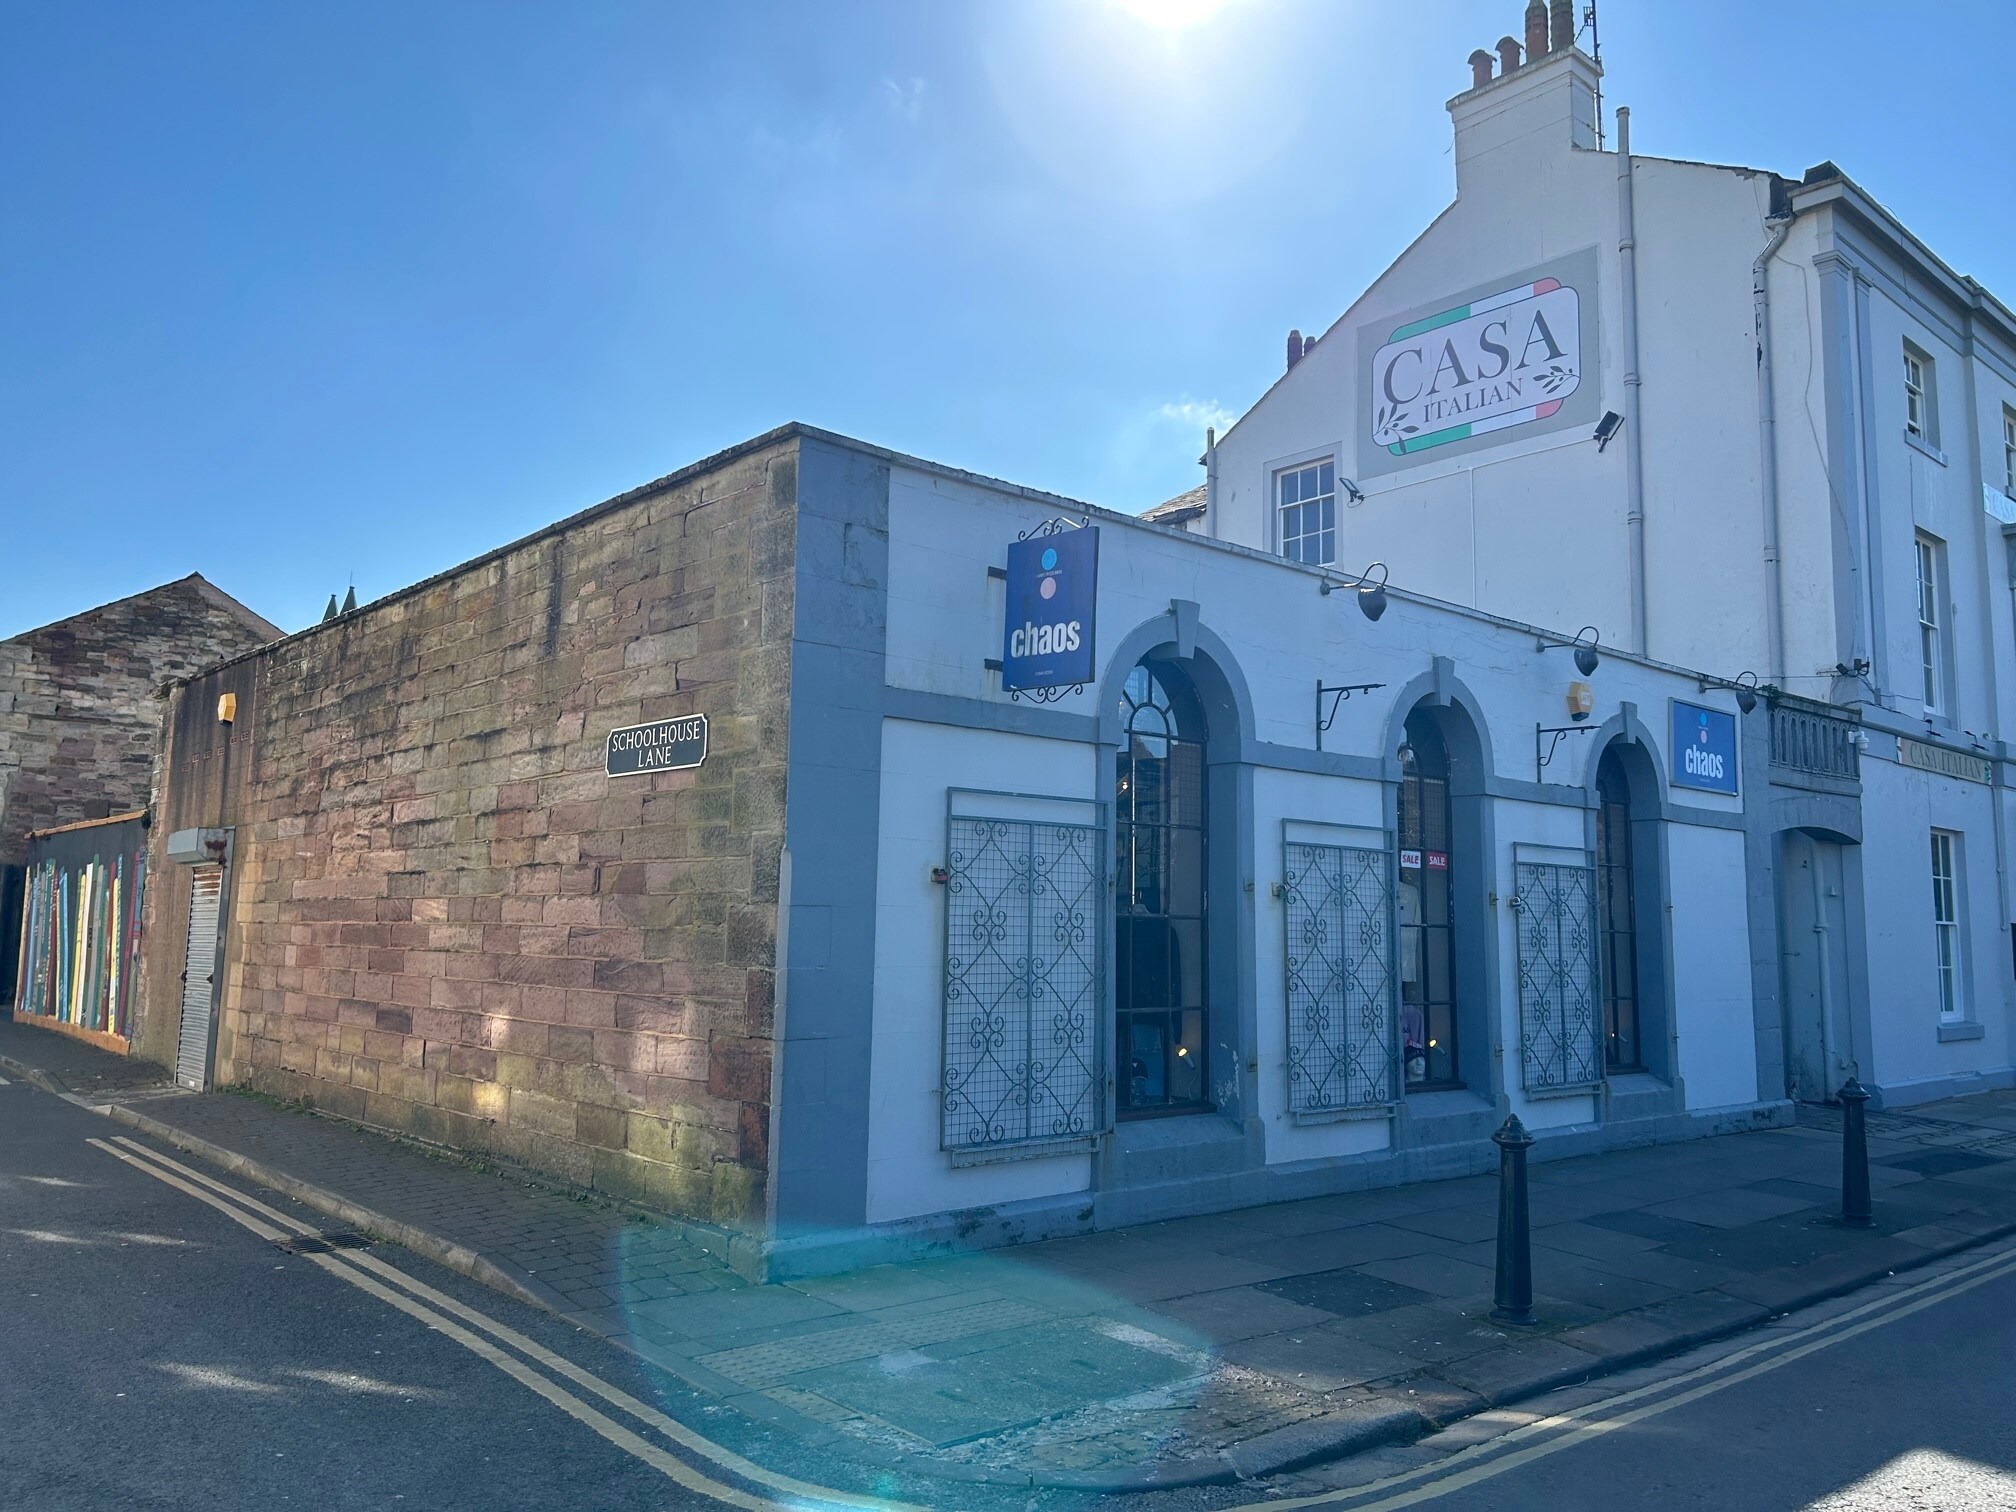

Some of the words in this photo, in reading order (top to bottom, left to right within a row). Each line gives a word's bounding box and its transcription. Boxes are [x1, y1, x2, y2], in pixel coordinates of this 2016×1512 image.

[1383, 309, 1568, 405] CASA
[1424, 377, 1523, 423] ITALIAN
[1010, 621, 1080, 658] chaos
[612, 720, 700, 752] SCHOOLHOUSE
[638, 746, 671, 767] LANE
[1685, 744, 1723, 779] chaos
[1910, 743, 1938, 769] CASA
[1941, 751, 1982, 779] ITALIAN
[1402, 854, 1419, 865] SALE
[1429, 856, 1446, 866] SALE
